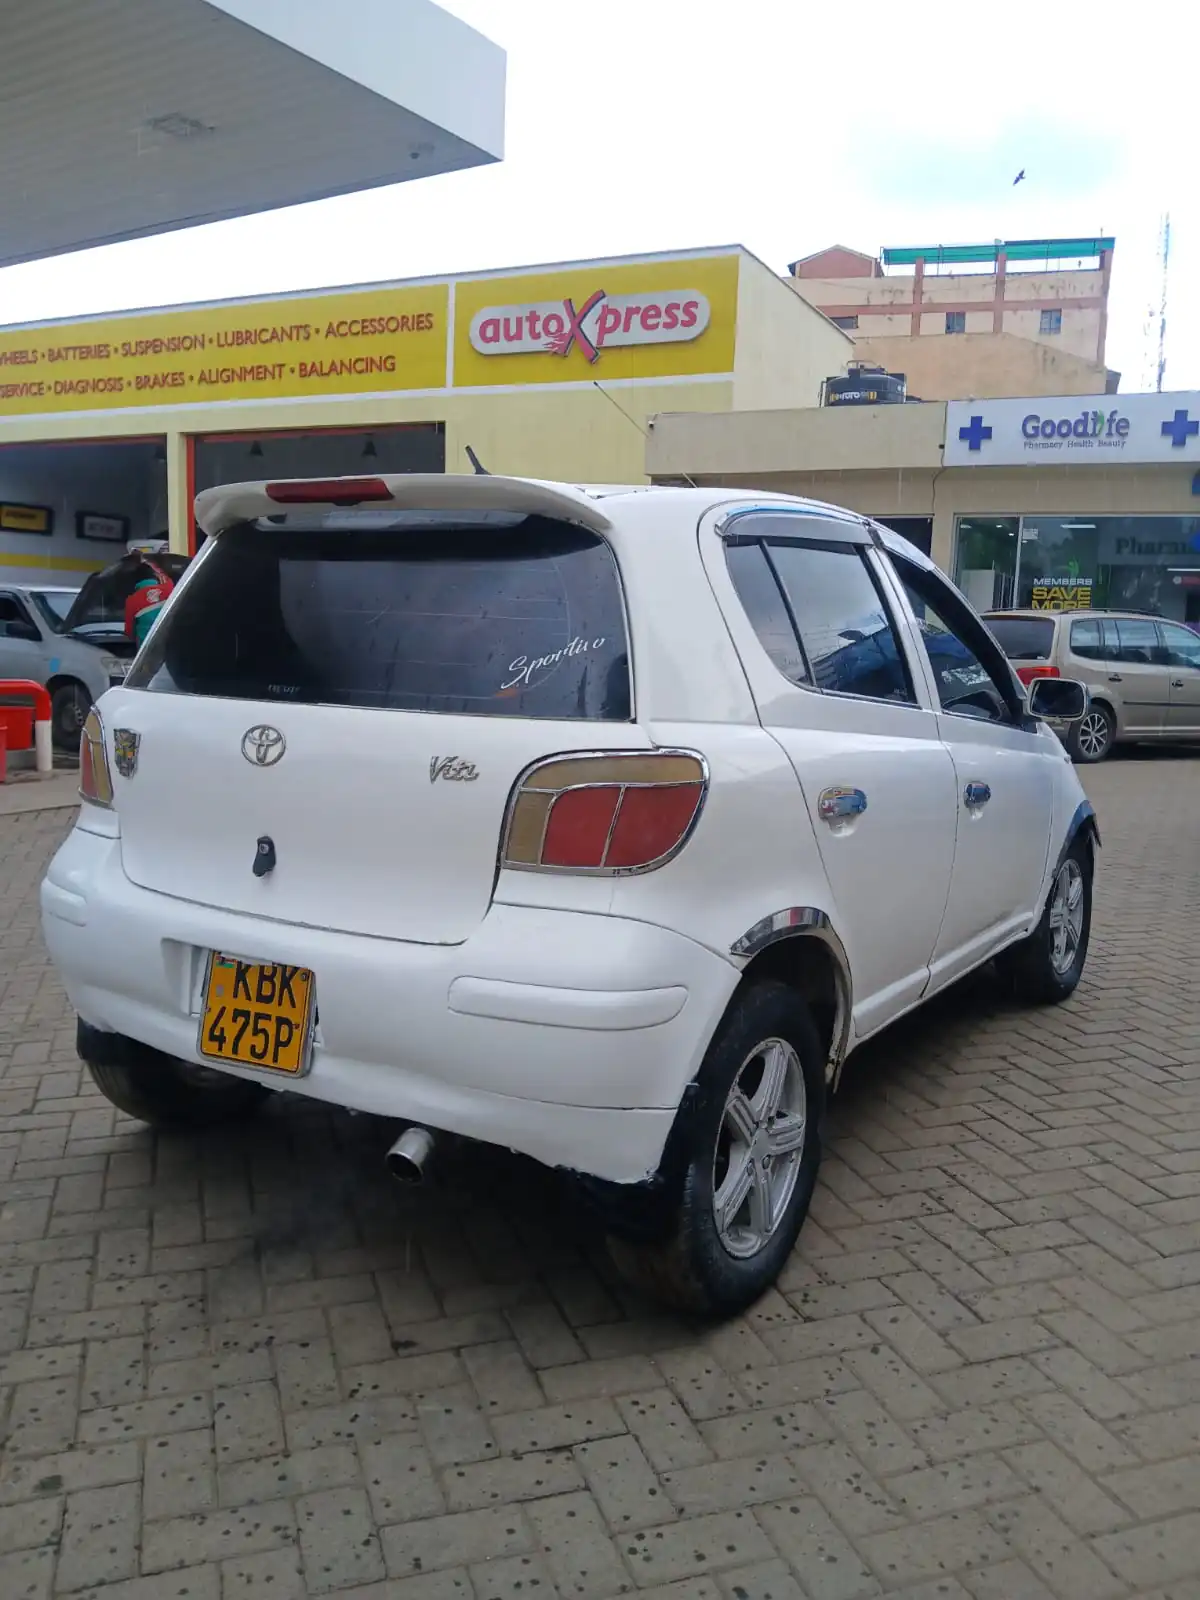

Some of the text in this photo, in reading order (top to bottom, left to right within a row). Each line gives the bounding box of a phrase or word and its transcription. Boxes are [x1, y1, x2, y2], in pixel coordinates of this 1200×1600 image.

[48, 344, 110, 362] BATTERIES
[121, 333, 205, 357] SUSPENSION
[217, 324, 311, 348] LUBRICANTS
[325, 313, 434, 338] ACCESSORIES
[479, 289, 699, 364] autoXpress
[0, 355, 397, 398] SERVICE DIAGNOSIS BRAKES ALIGNMENT BALANCING
[1021, 409, 1130, 438] Goodlife
[1023, 440, 1063, 450] Pharmacy
[1067, 440, 1094, 449] Health
[1032, 586, 1091, 600] SAVE
[1033, 577, 1093, 586] MEMBERS
[1032, 600, 1091, 610] MORE
[232, 961, 300, 1009] KBK
[207, 1005, 294, 1064] 475P
